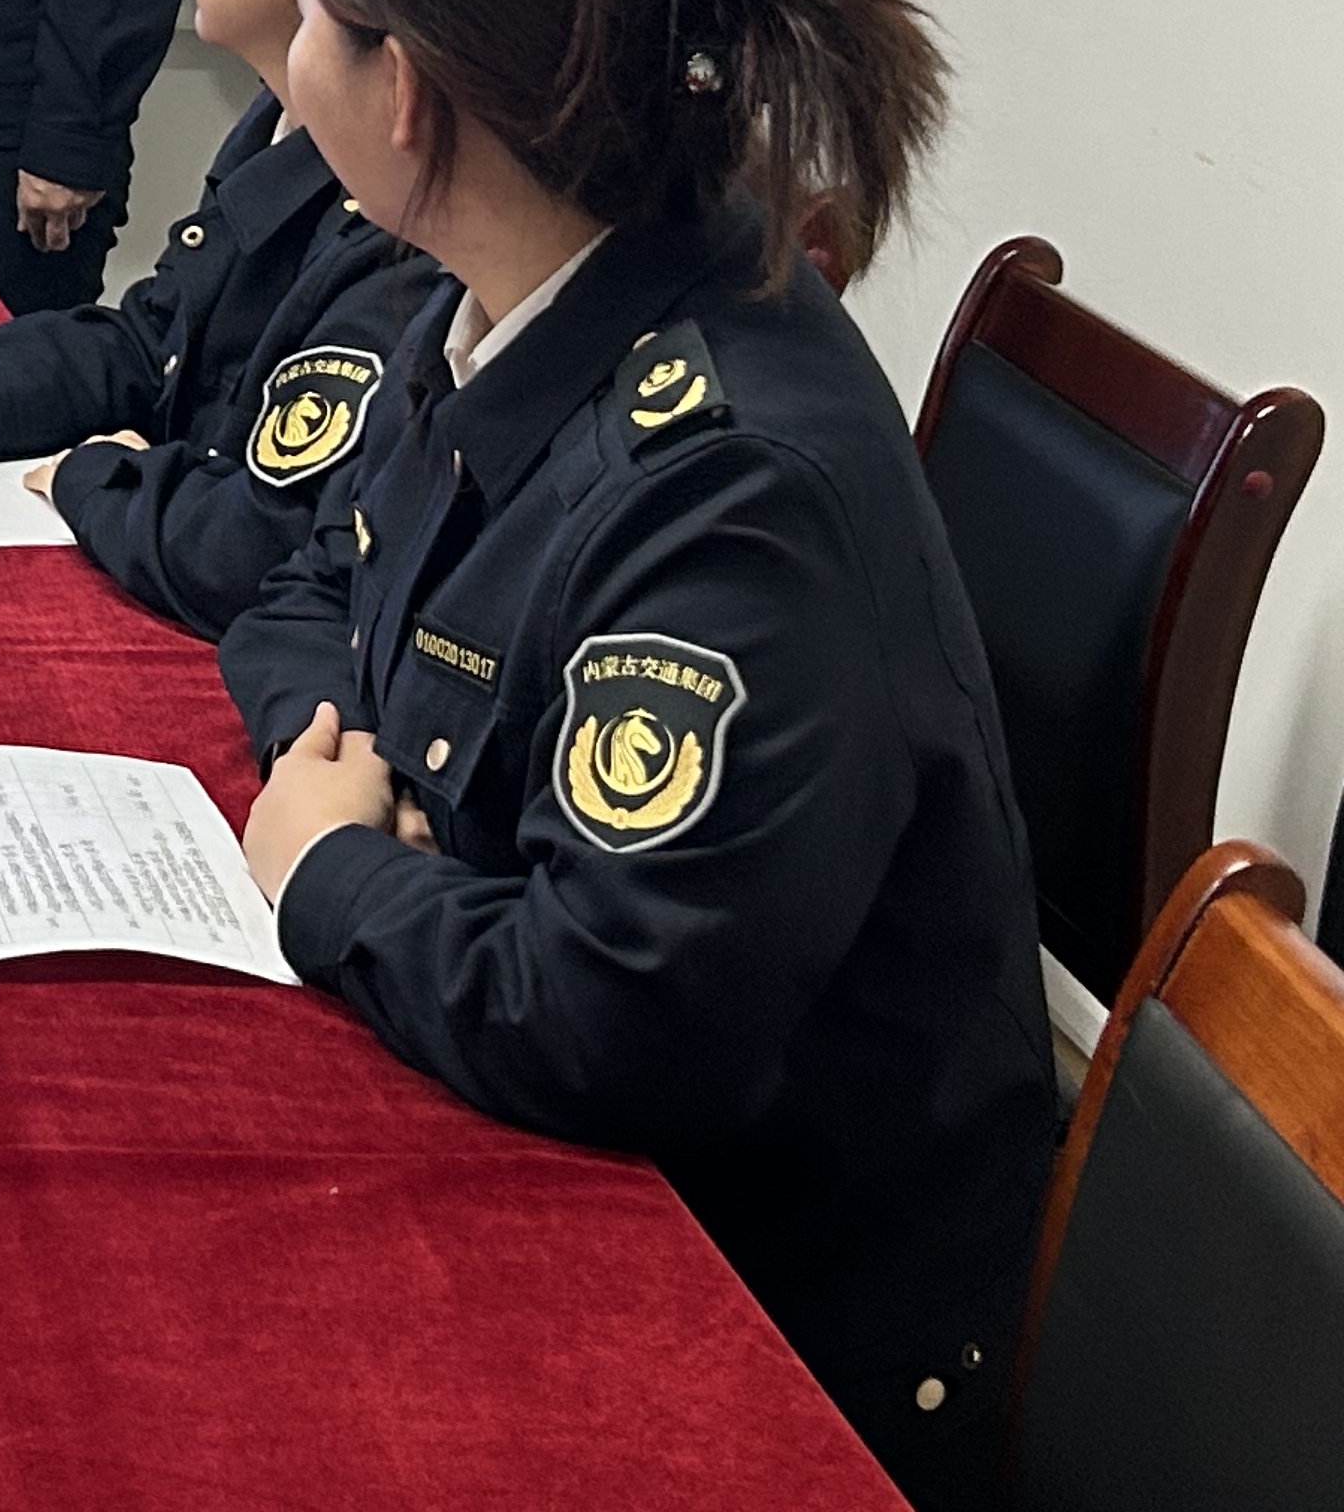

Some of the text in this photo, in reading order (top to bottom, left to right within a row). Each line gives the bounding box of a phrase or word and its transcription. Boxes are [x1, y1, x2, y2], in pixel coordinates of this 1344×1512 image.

[415, 627, 496, 681] 01002013017
[583, 653, 722, 702] 内蒙古交通集团
